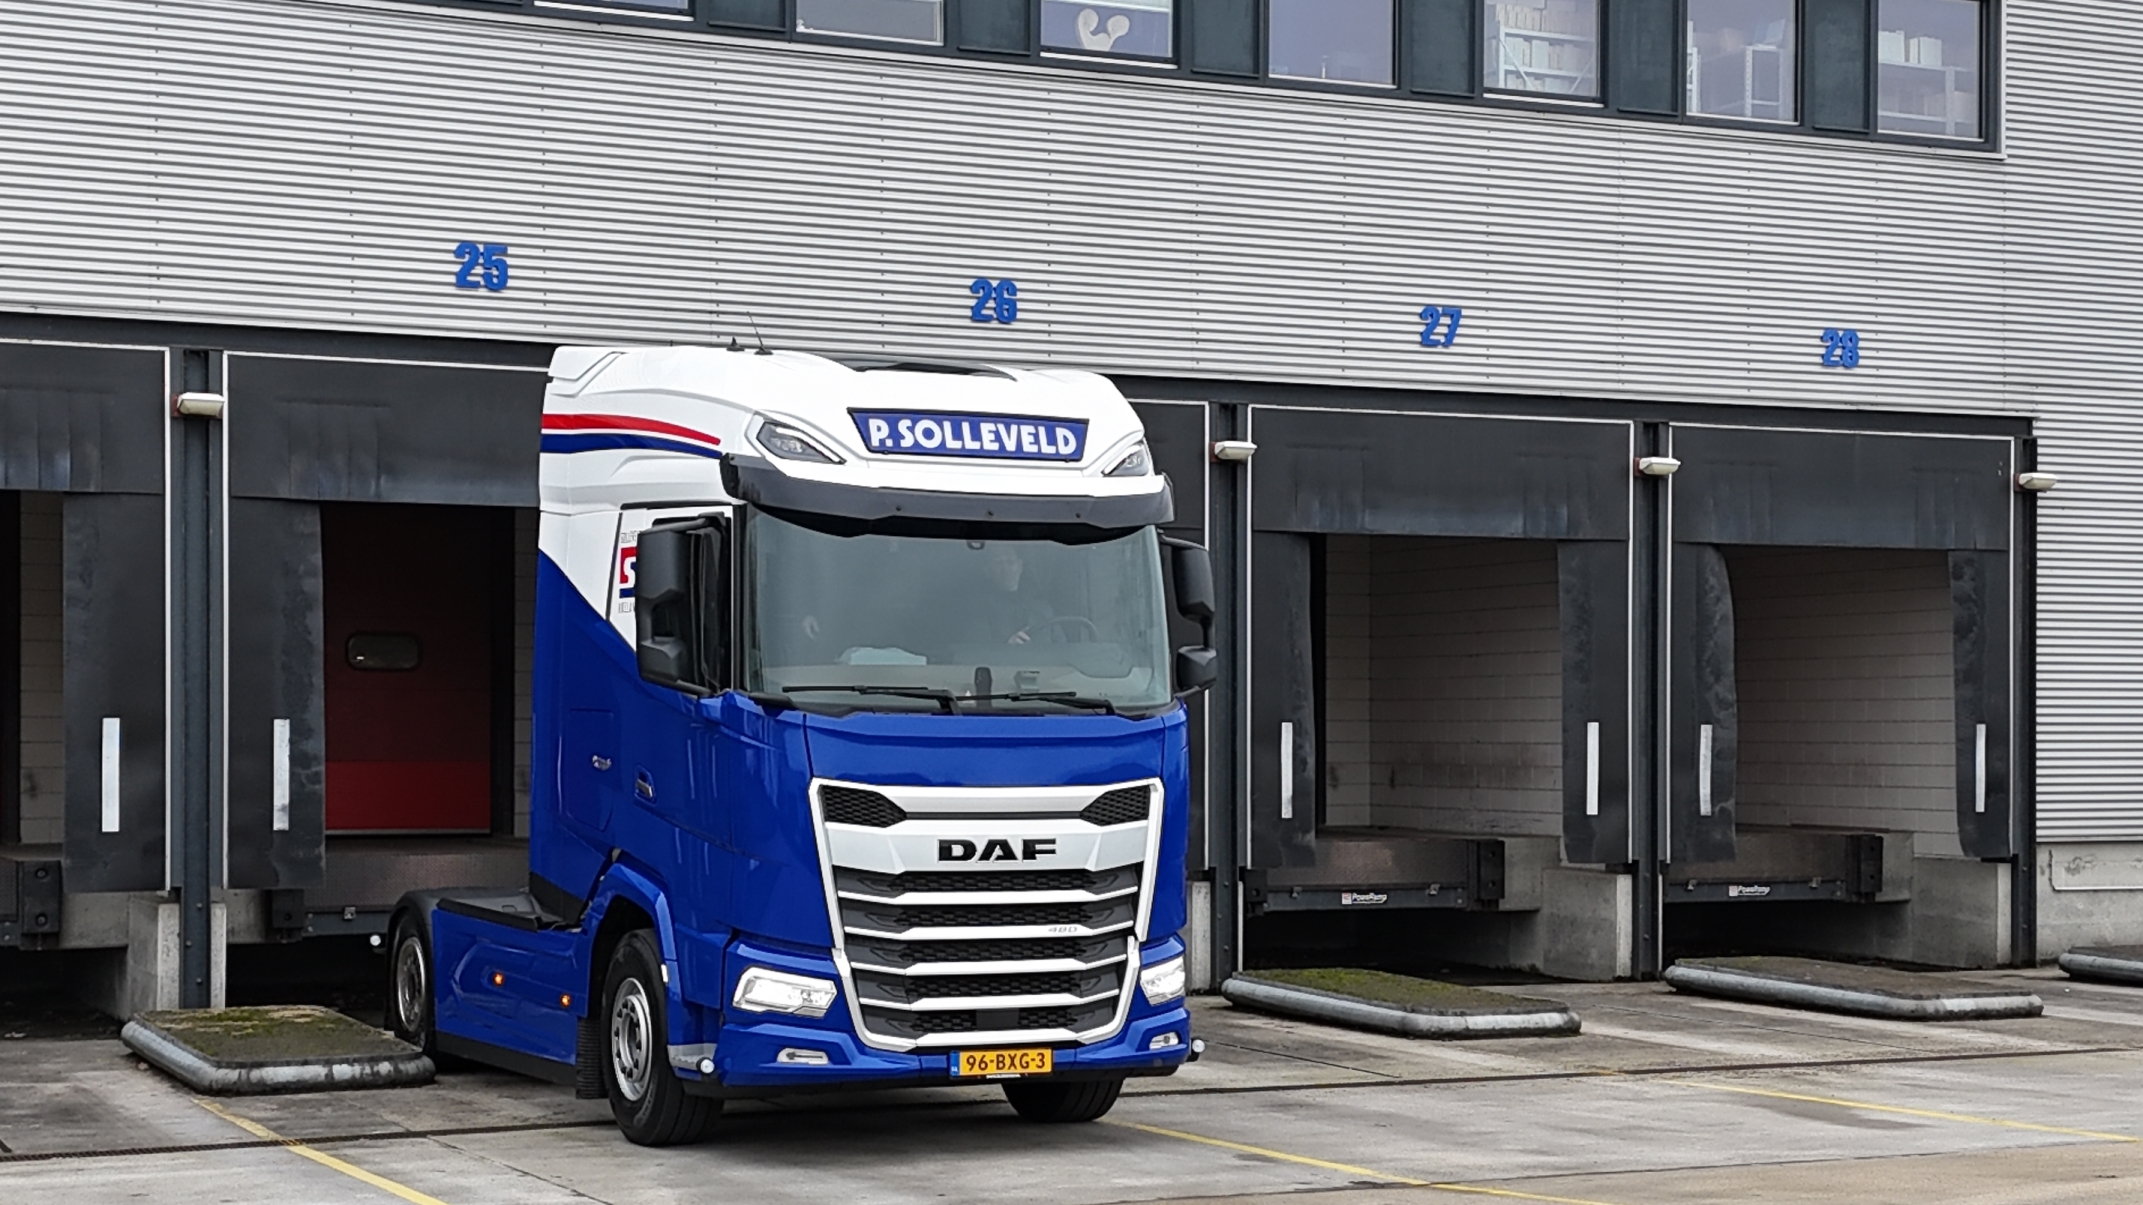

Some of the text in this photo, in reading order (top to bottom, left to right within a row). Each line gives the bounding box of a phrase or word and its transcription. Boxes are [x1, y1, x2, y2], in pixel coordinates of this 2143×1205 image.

[454, 242, 509, 290] 25
[971, 278, 1017, 322] 26
[1420, 306, 1462, 346] 27
[1822, 328, 1860, 368] 28
[868, 418, 1077, 455] P. SOLLEVELD
[938, 838, 1057, 862] DAF
[966, 1052, 1046, 1072] 96-BXG-3
